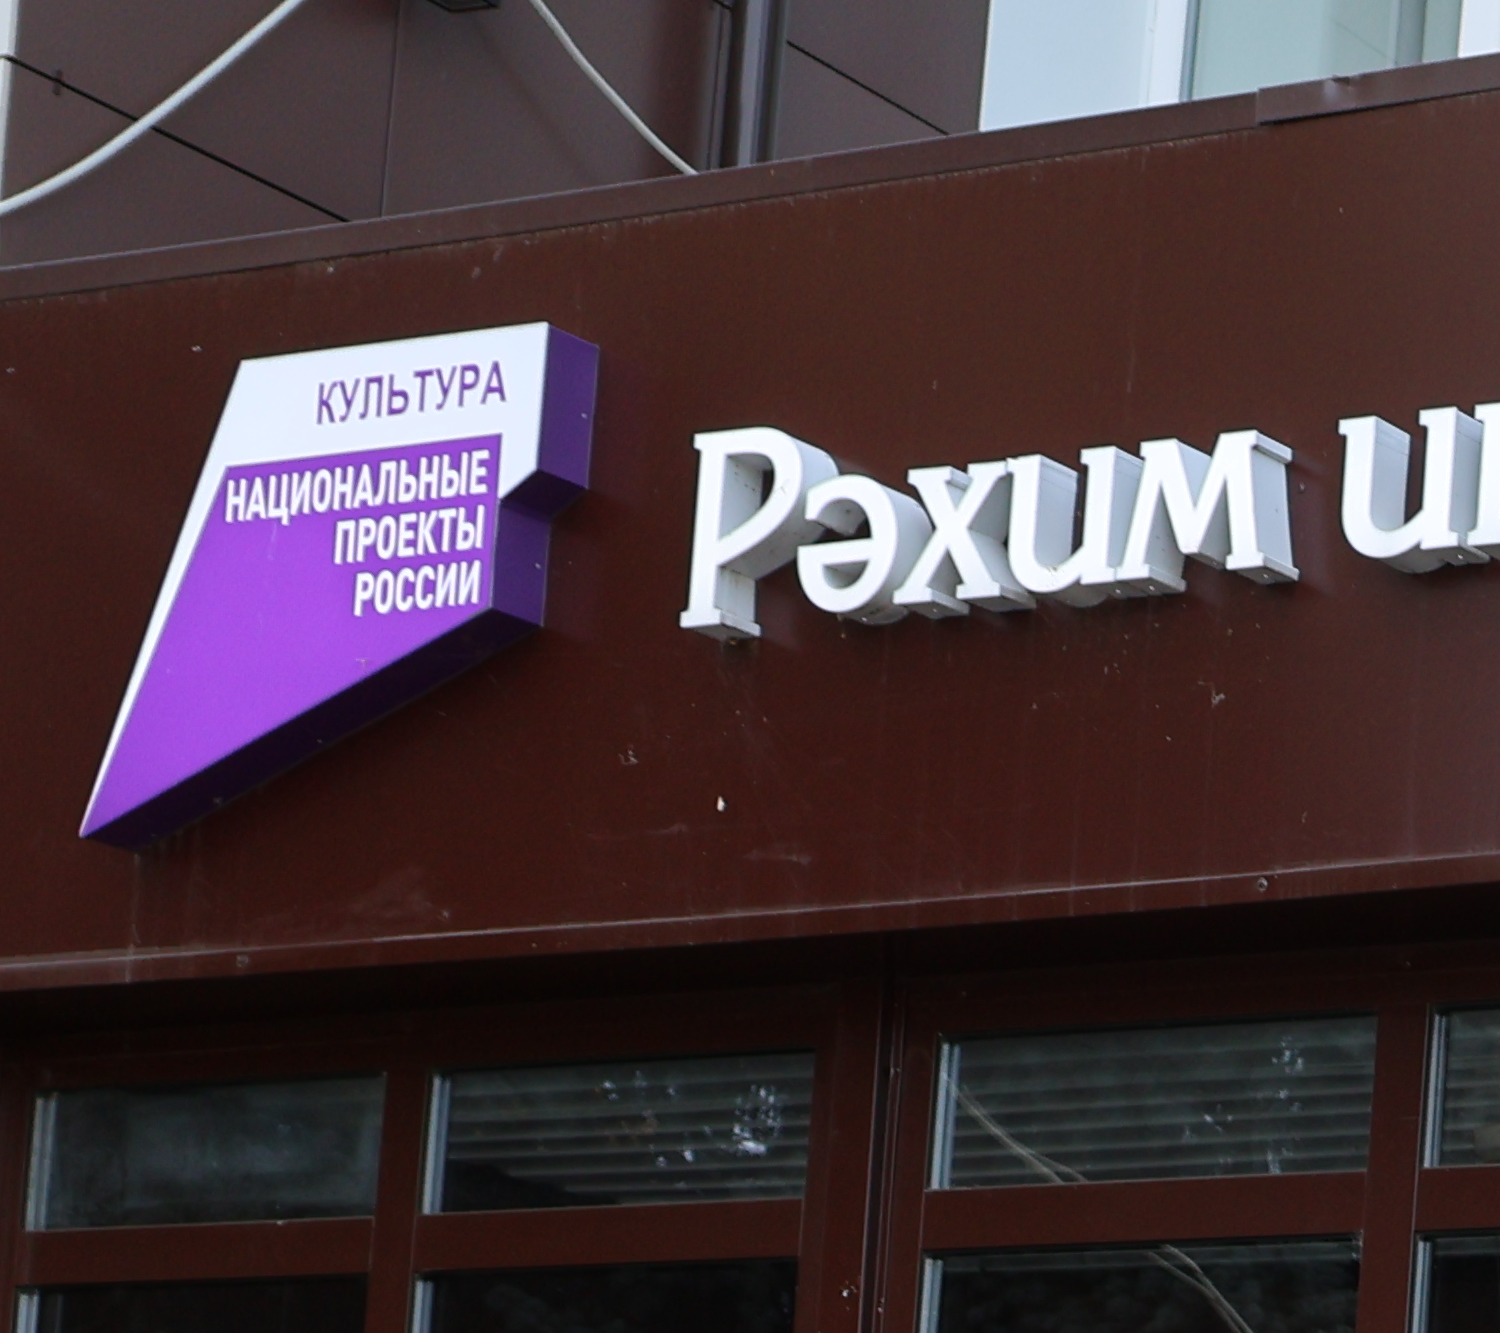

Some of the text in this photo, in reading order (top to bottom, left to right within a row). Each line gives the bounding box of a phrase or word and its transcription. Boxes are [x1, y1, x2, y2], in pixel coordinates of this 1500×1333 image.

[316, 361, 507, 425] КУЛЬТУРА
[224, 449, 490, 526] НАЦИОНАЛЬНЫЕ
[334, 504, 486, 565] ПРОЕКТЫ
[680, 427, 1299, 640] Рәхим
[353, 559, 482, 617] РОССИИ
